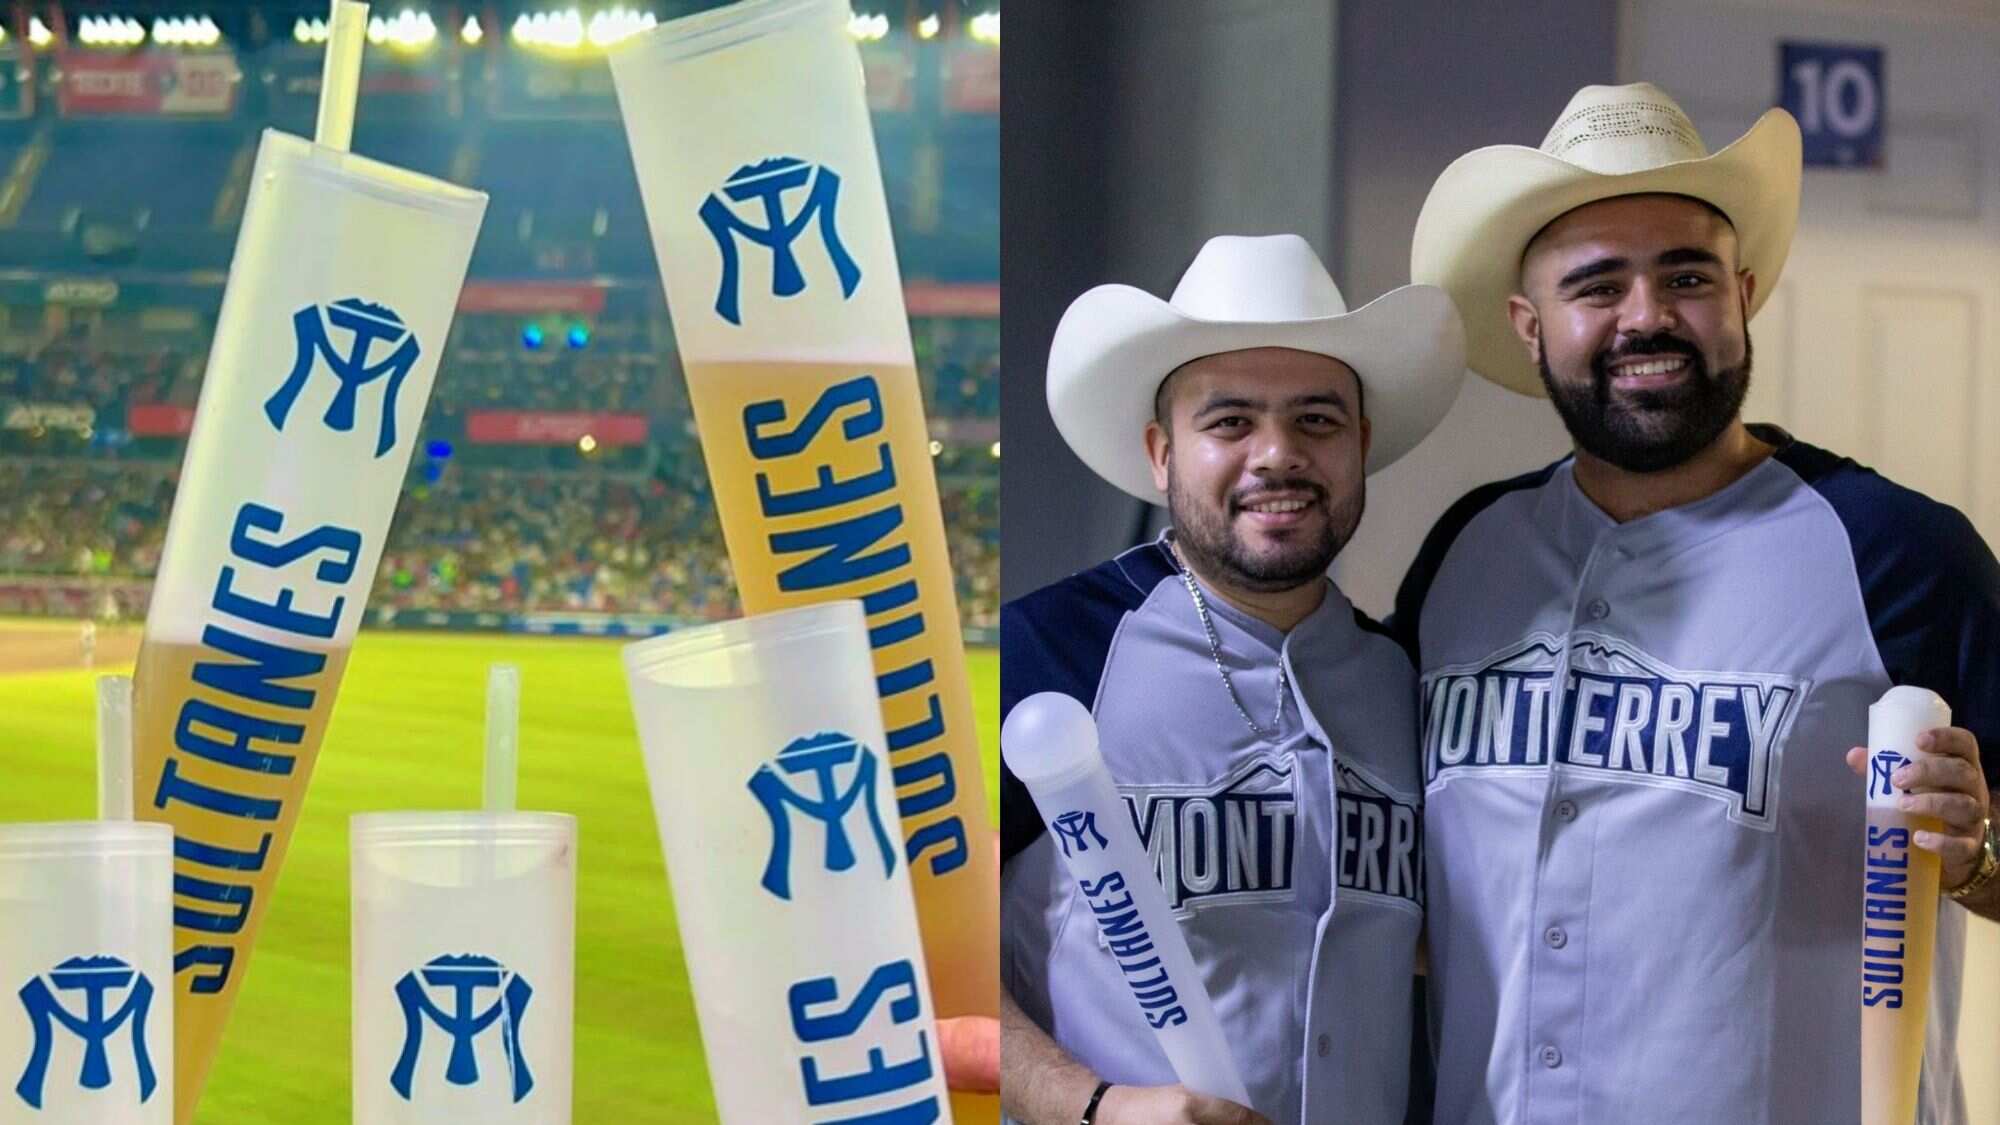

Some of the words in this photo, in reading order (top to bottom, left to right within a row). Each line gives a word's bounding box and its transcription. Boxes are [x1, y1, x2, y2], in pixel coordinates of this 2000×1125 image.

[1791, 59, 1877, 137] 10
[1121, 794, 1424, 909] MONTERR
[1863, 823, 1910, 1010] SULTANES
[1079, 870, 1189, 1031] SULTANES
